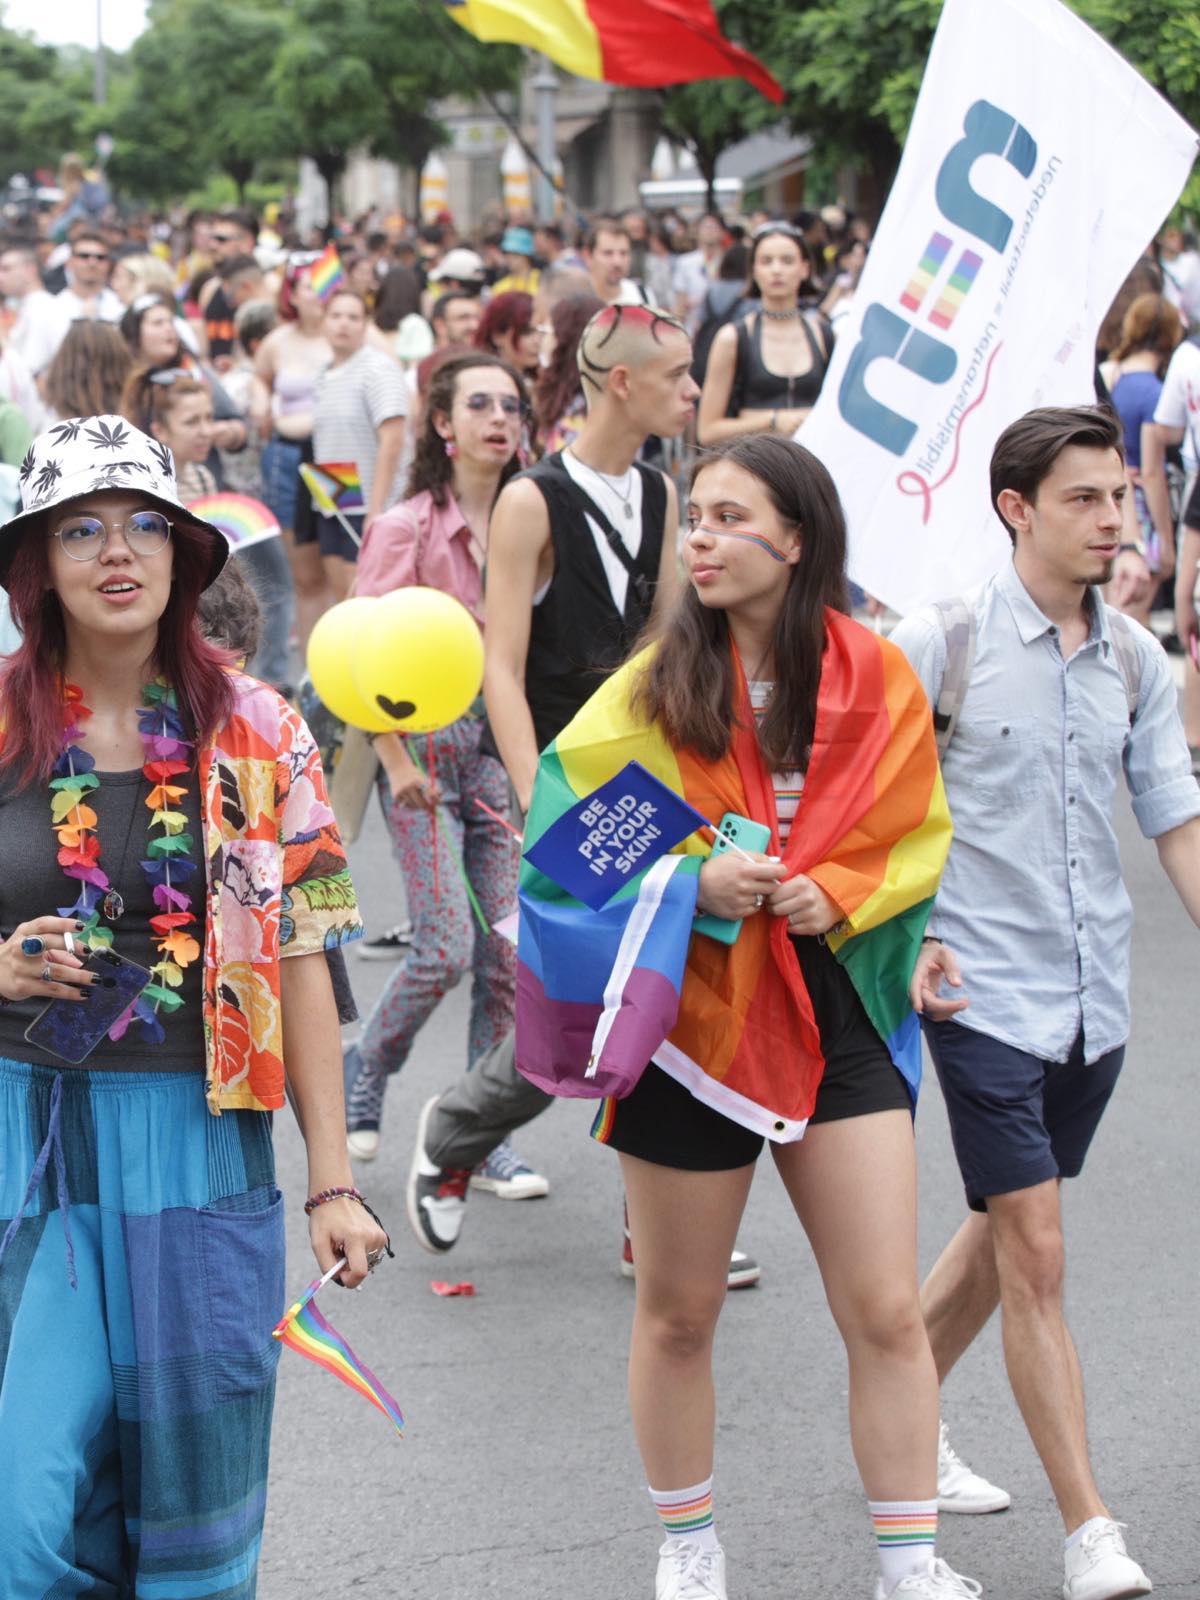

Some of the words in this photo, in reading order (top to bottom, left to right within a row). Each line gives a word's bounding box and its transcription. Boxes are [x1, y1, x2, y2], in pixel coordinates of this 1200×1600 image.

[578, 799, 608, 827] BE
[578, 794, 637, 860] PROUD
[589, 850, 614, 876] IN
[606, 801, 658, 850] YOUR
[614, 824, 662, 875] SKIN!
